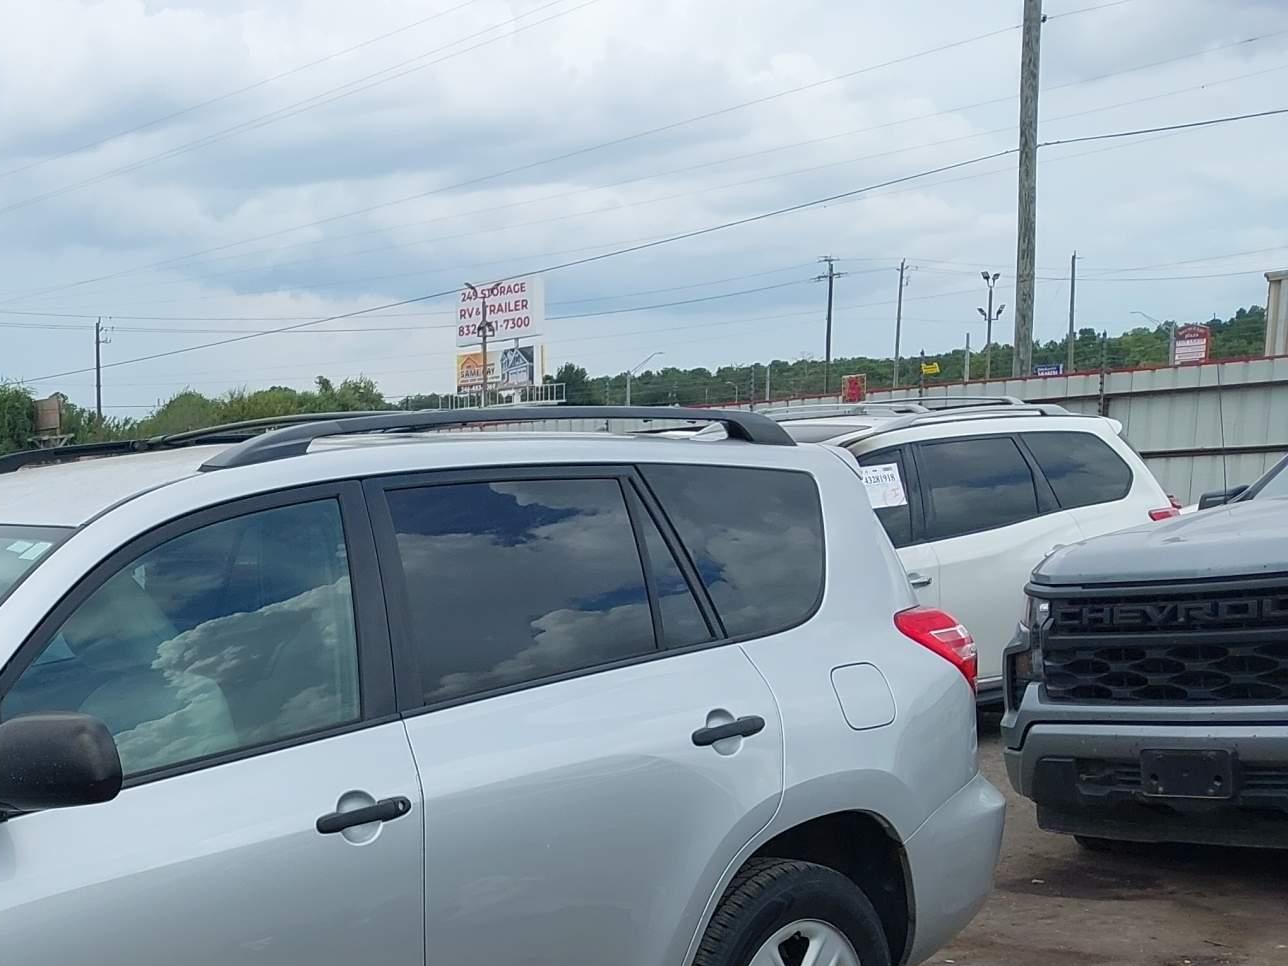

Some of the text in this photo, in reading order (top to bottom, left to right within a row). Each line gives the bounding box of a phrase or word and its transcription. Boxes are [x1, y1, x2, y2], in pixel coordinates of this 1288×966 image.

[461, 282, 526, 302] 249 STORAGE
[459, 299, 529, 320] RV & RAILER
